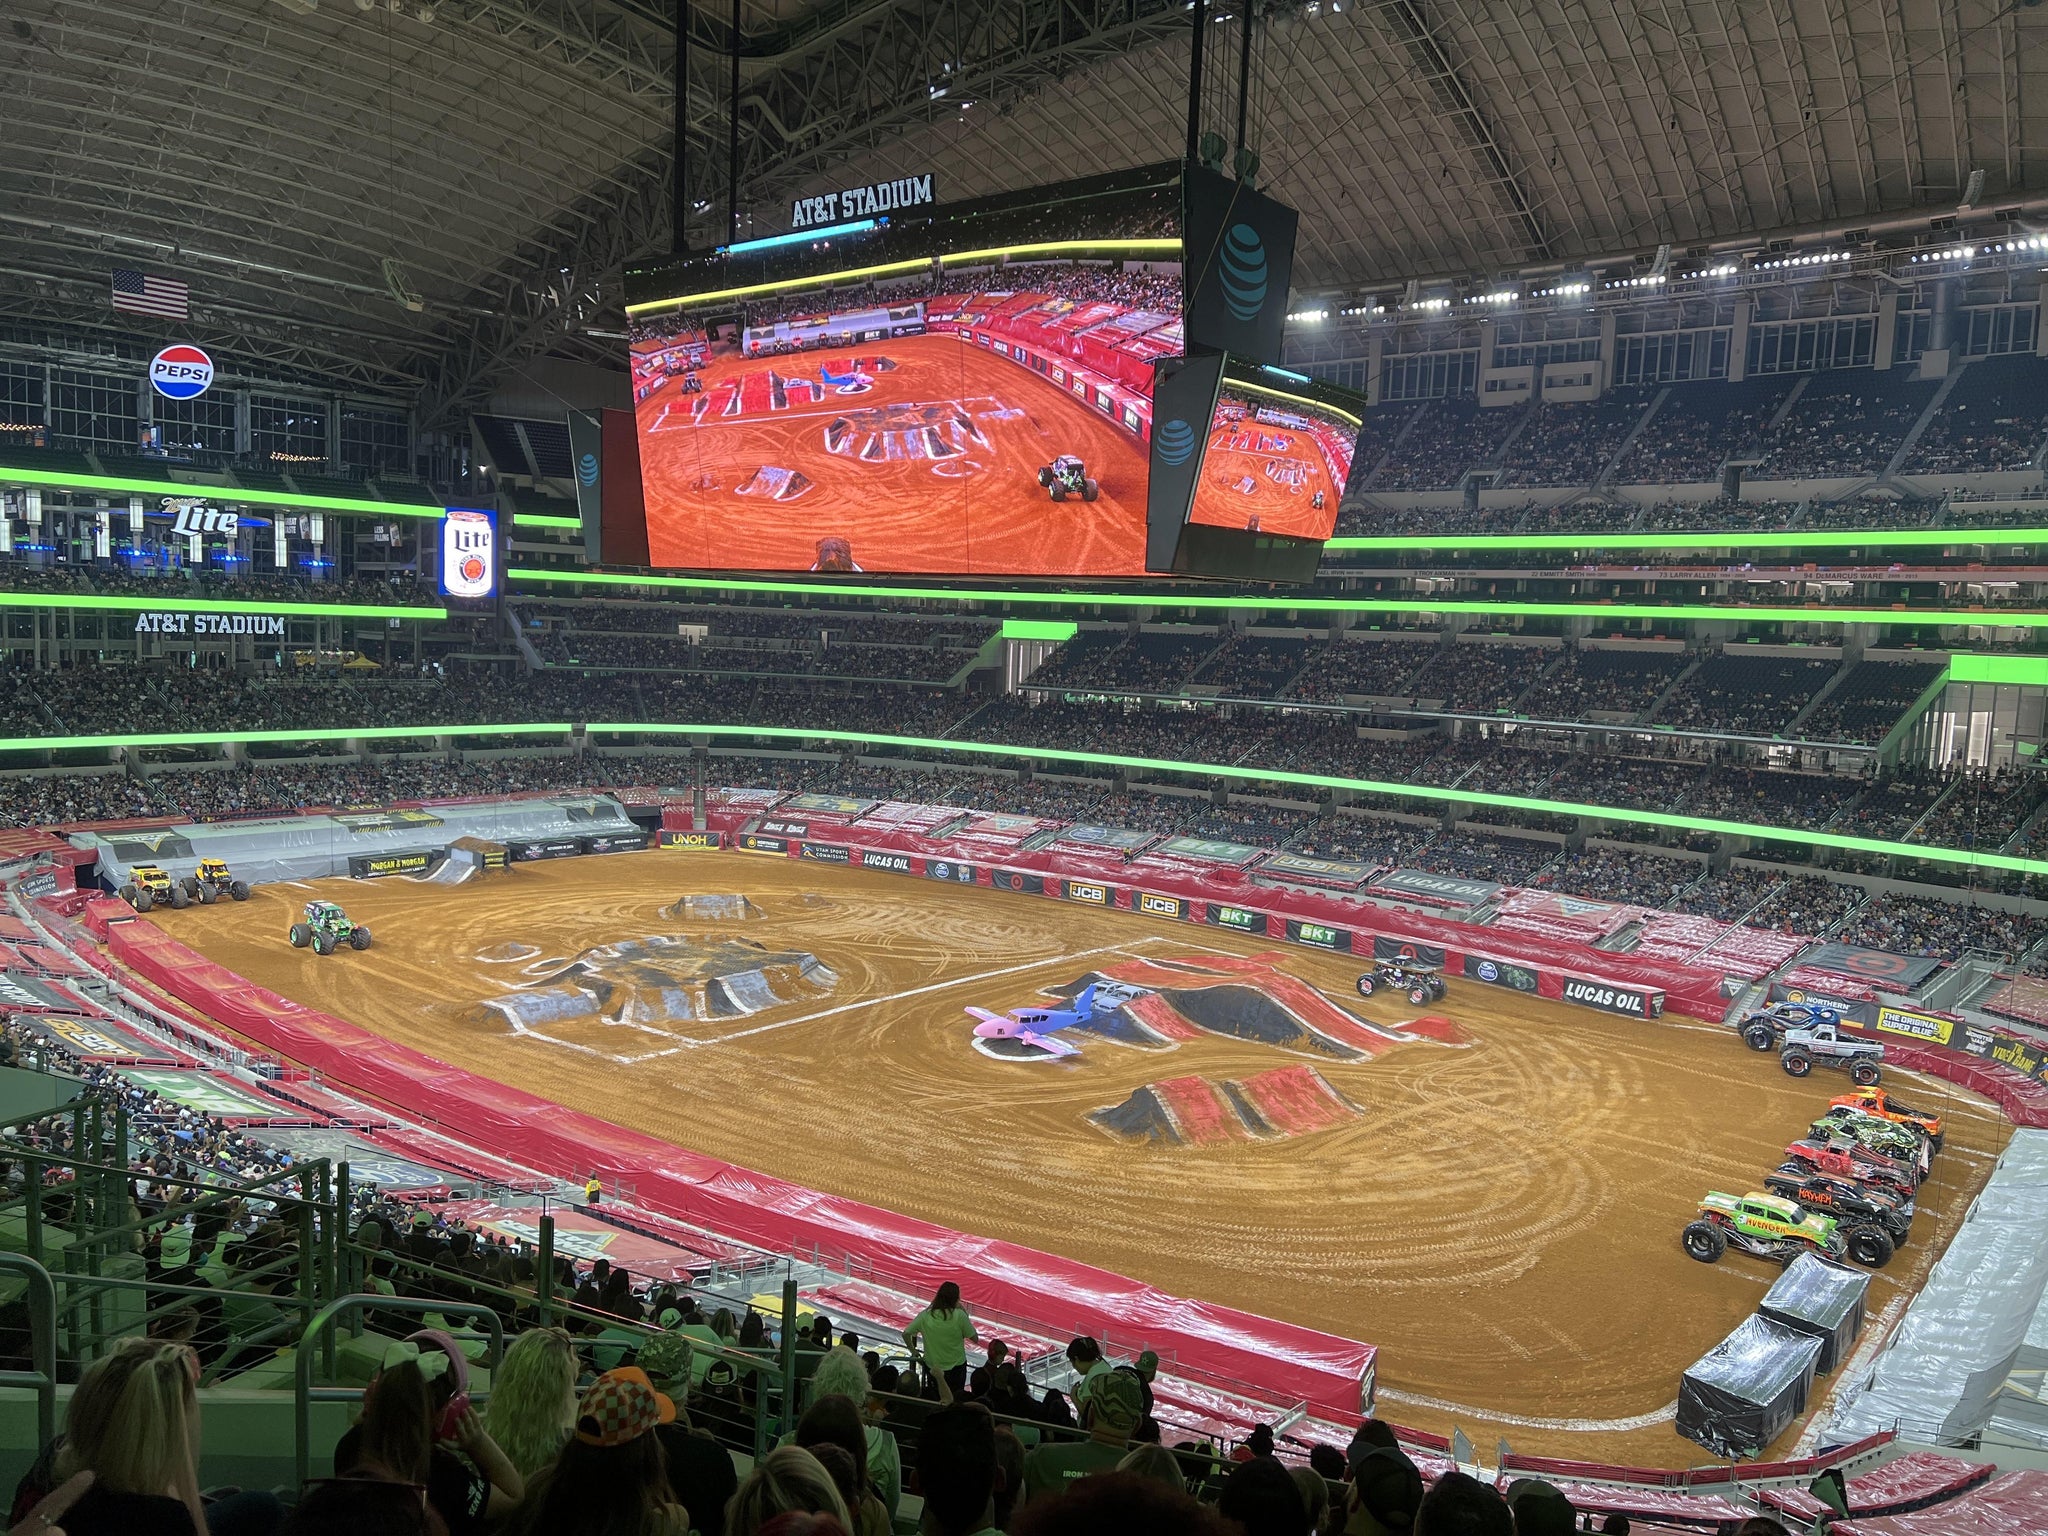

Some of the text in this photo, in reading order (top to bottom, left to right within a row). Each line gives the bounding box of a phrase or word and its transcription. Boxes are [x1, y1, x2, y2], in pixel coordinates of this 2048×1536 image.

[792, 174, 933, 227] AT&T STADIUM
[154, 363, 210, 382] PEPSI
[170, 505, 239, 536] Lite
[454, 529, 490, 553] Lite
[135, 613, 285, 635] AT&T STADIUM
[672, 833, 707, 845] UNOH
[370, 856, 426, 870] MORGAN & MORGAN
[864, 853, 911, 870] LUCAS OIL
[1279, 856, 1328, 871] JCB
[1072, 886, 1103, 900] JCB
[1392, 874, 1490, 897] LUCAS OIL
[1144, 898, 1176, 913] JCB
[1220, 908, 1253, 924] BKT
[1300, 924, 1336, 941] BKT
[1566, 983, 1614, 1006] LUCAS
[1806, 996, 1850, 1010] NORTHERN
[1882, 1019, 1933, 1037] SUPER GLUE
[1884, 1012, 1939, 1031] THE ORIGINAL
[2013, 1043, 2025, 1055] THE
[1992, 1046, 2016, 1063] VIDEO
[2011, 1054, 2036, 1073] GAME
[1798, 1187, 1832, 1205] MAYHEM
[1063, 1470, 1083, 1479] IRON
[469, 1491, 482, 1518] SEND
